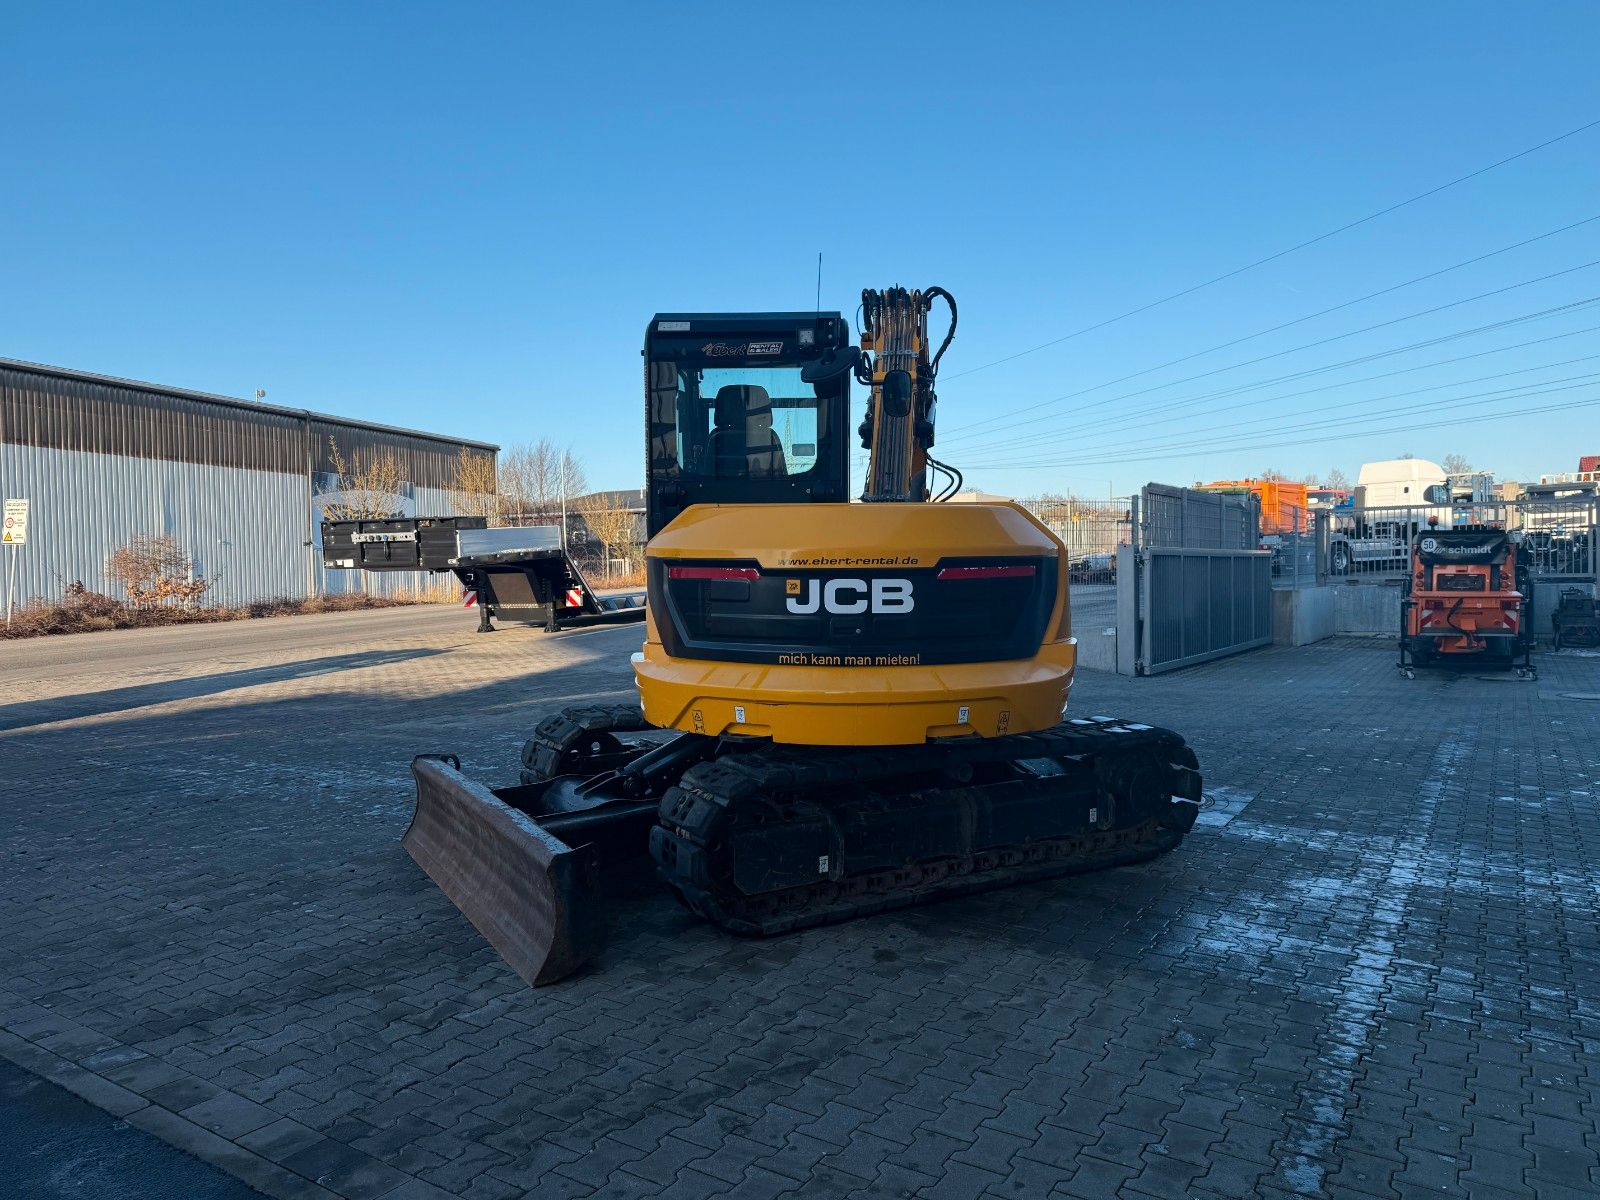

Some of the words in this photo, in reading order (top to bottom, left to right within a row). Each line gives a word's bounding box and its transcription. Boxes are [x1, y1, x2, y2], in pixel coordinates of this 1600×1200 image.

[1423, 540, 1434, 550] 50
[1448, 546, 1492, 554] schmidt
[777, 556, 919, 566] www.ebert-rental.de
[786, 578, 915, 614] JCB
[779, 653, 807, 665] mich
[811, 653, 841, 665] kann
[844, 655, 872, 665] man
[875, 653, 920, 665] mieten!
